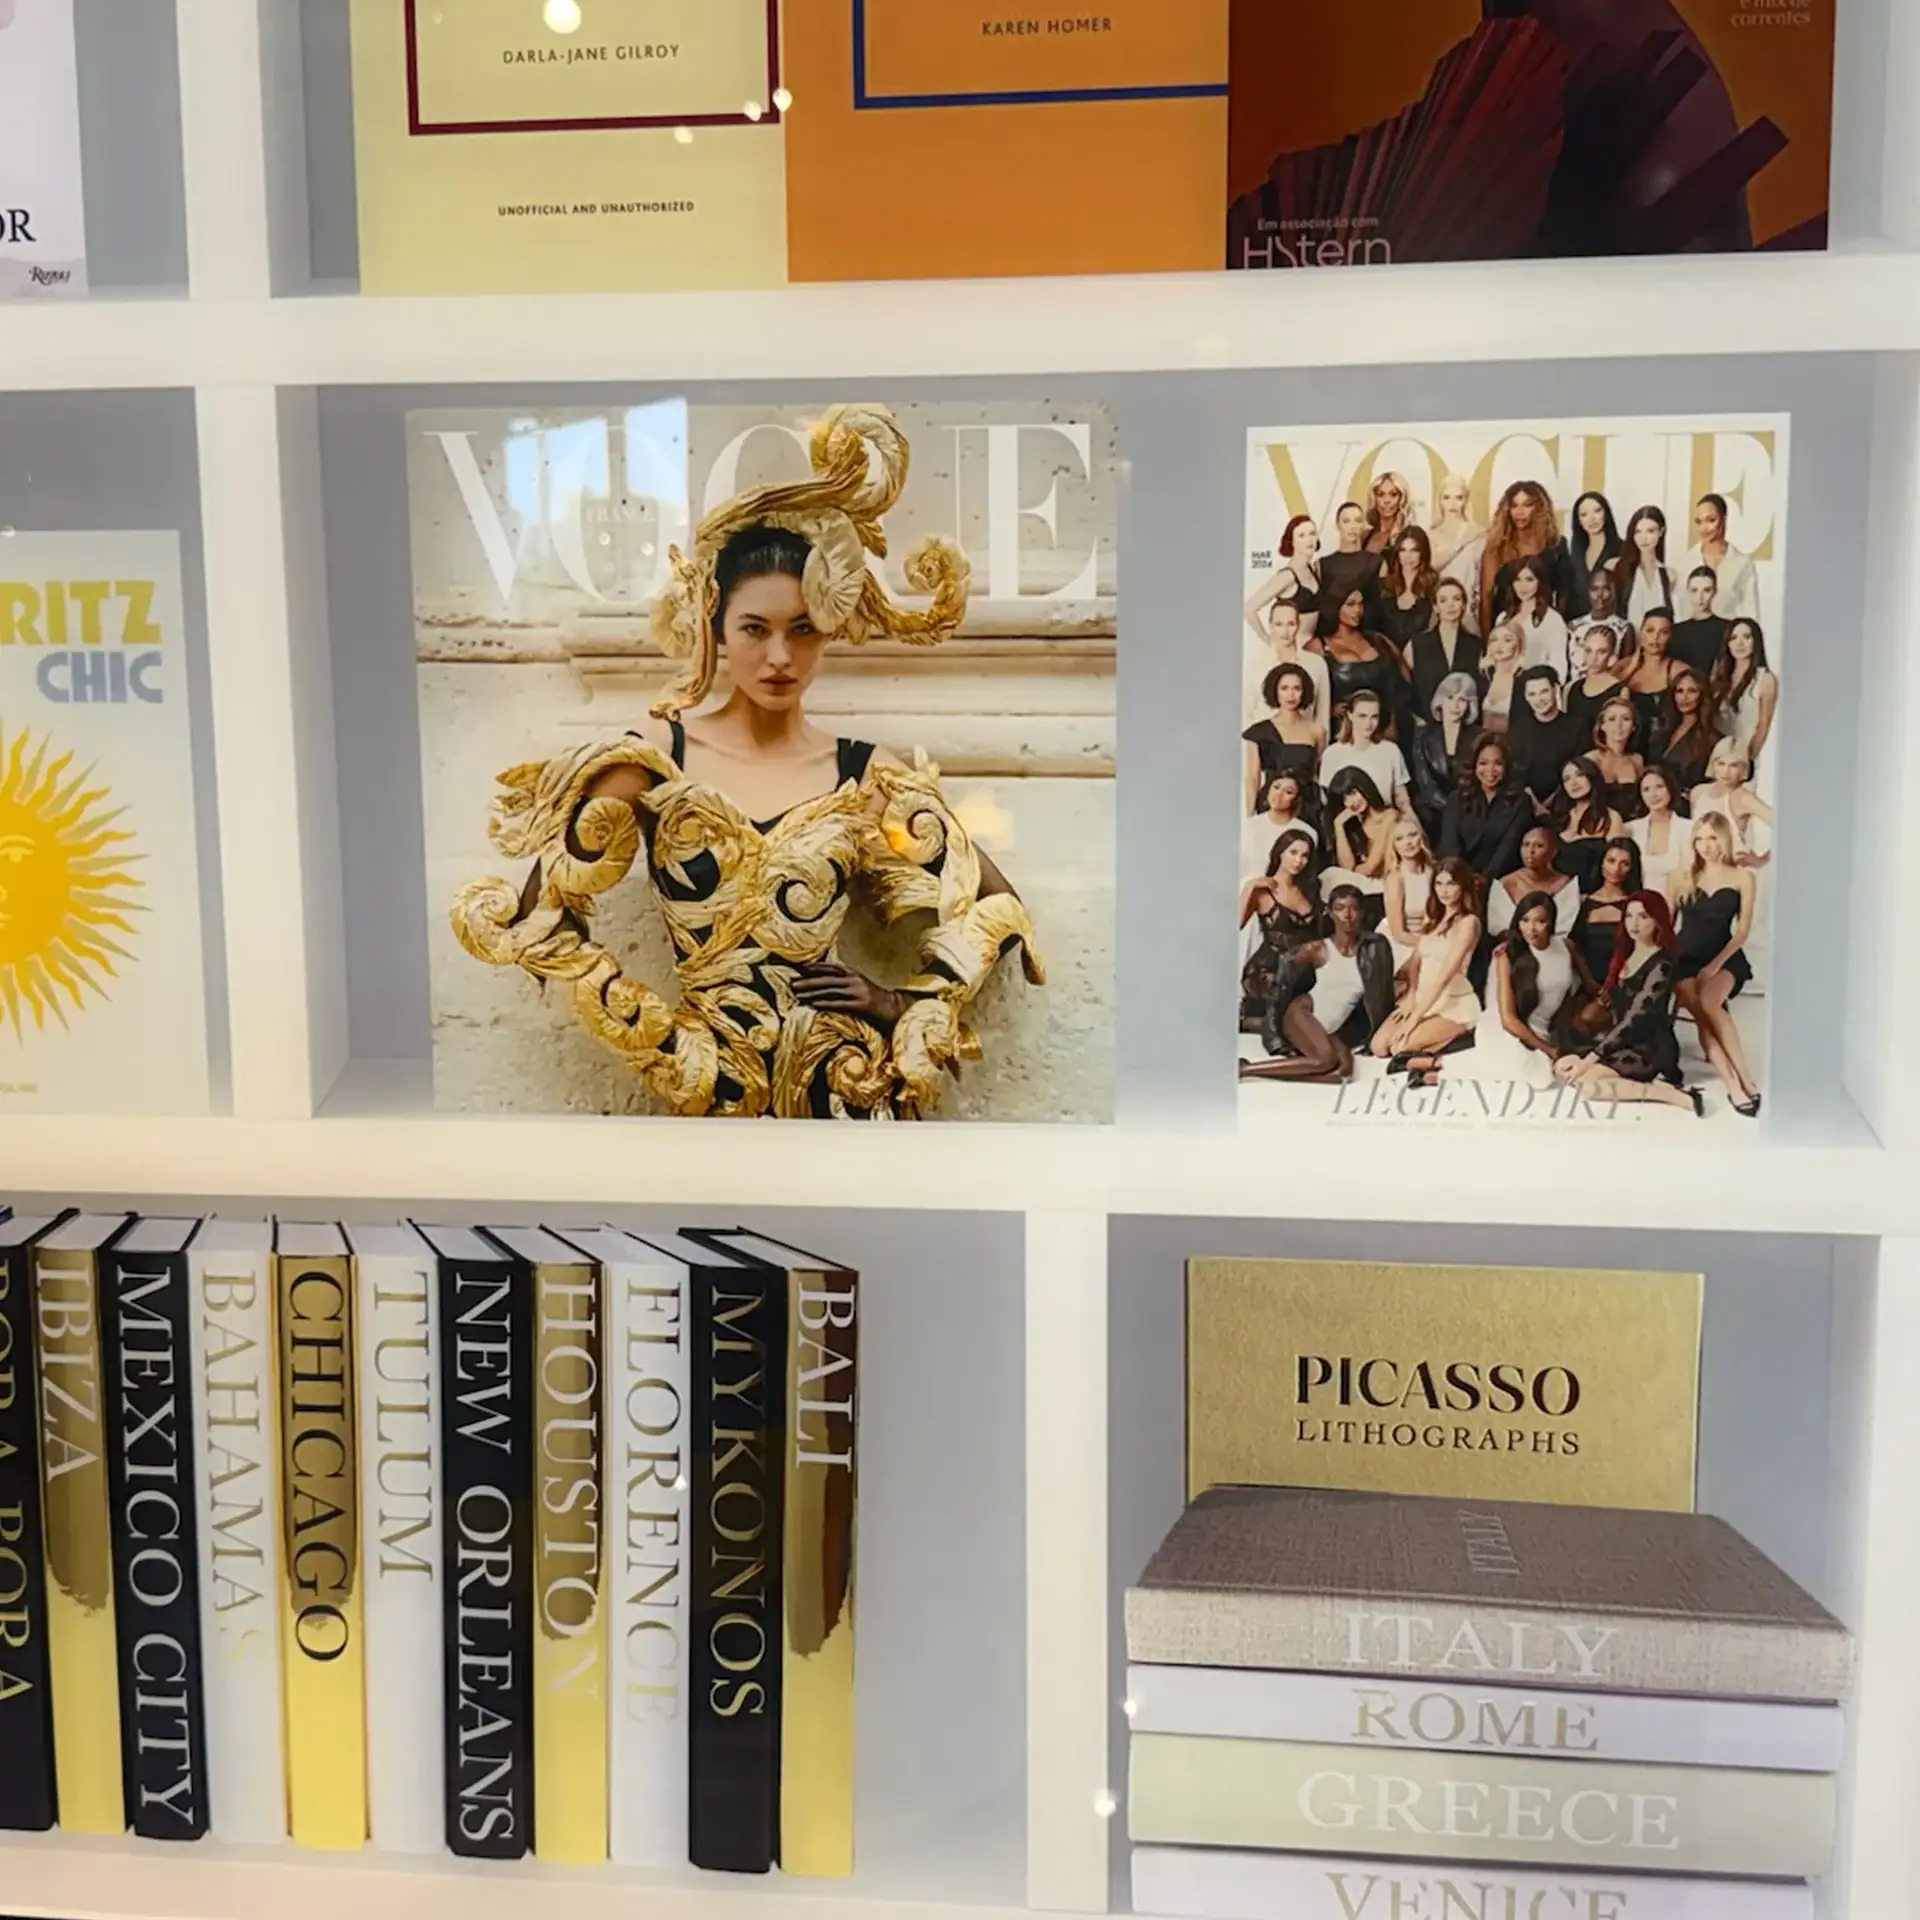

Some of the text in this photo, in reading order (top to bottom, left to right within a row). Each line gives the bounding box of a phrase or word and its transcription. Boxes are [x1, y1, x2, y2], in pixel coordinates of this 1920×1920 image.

[503, 44, 680, 65] DARLA-JANE GILROY
[982, 16, 1112, 36] KAREN HOMER
[0, 208, 37, 243] R
[498, 200, 695, 217] UNOFFICIAL AND UNAUTHORIZED
[1257, 217, 1278, 231] Em
[1351, 216, 1379, 228] com
[37, 651, 163, 703] CHIC
[36, 1259, 100, 1482] IBIZA
[795, 1282, 856, 1473] BALI
[1296, 1354, 1582, 1416] PICASSO
[372, 1270, 434, 1581] TULUM
[1296, 1418, 1582, 1456] LITHOGRAPHS
[288, 1270, 350, 1662] CHICAGO
[538, 1277, 599, 1701] HOUSTON
[625, 1279, 681, 1723] FLORENCE
[709, 1284, 767, 1716] MYKONOS
[116, 1265, 194, 1825] MEXICO CITY
[454, 1273, 515, 1842] NEW ORLEANS
[1458, 1509, 1520, 1574] ITALY
[1342, 1610, 1620, 1678] ITALY
[1350, 1689, 1600, 1752] ROME
[1296, 1771, 1680, 1850] GREECE
[1325, 1872, 1628, 1920] VENICE
